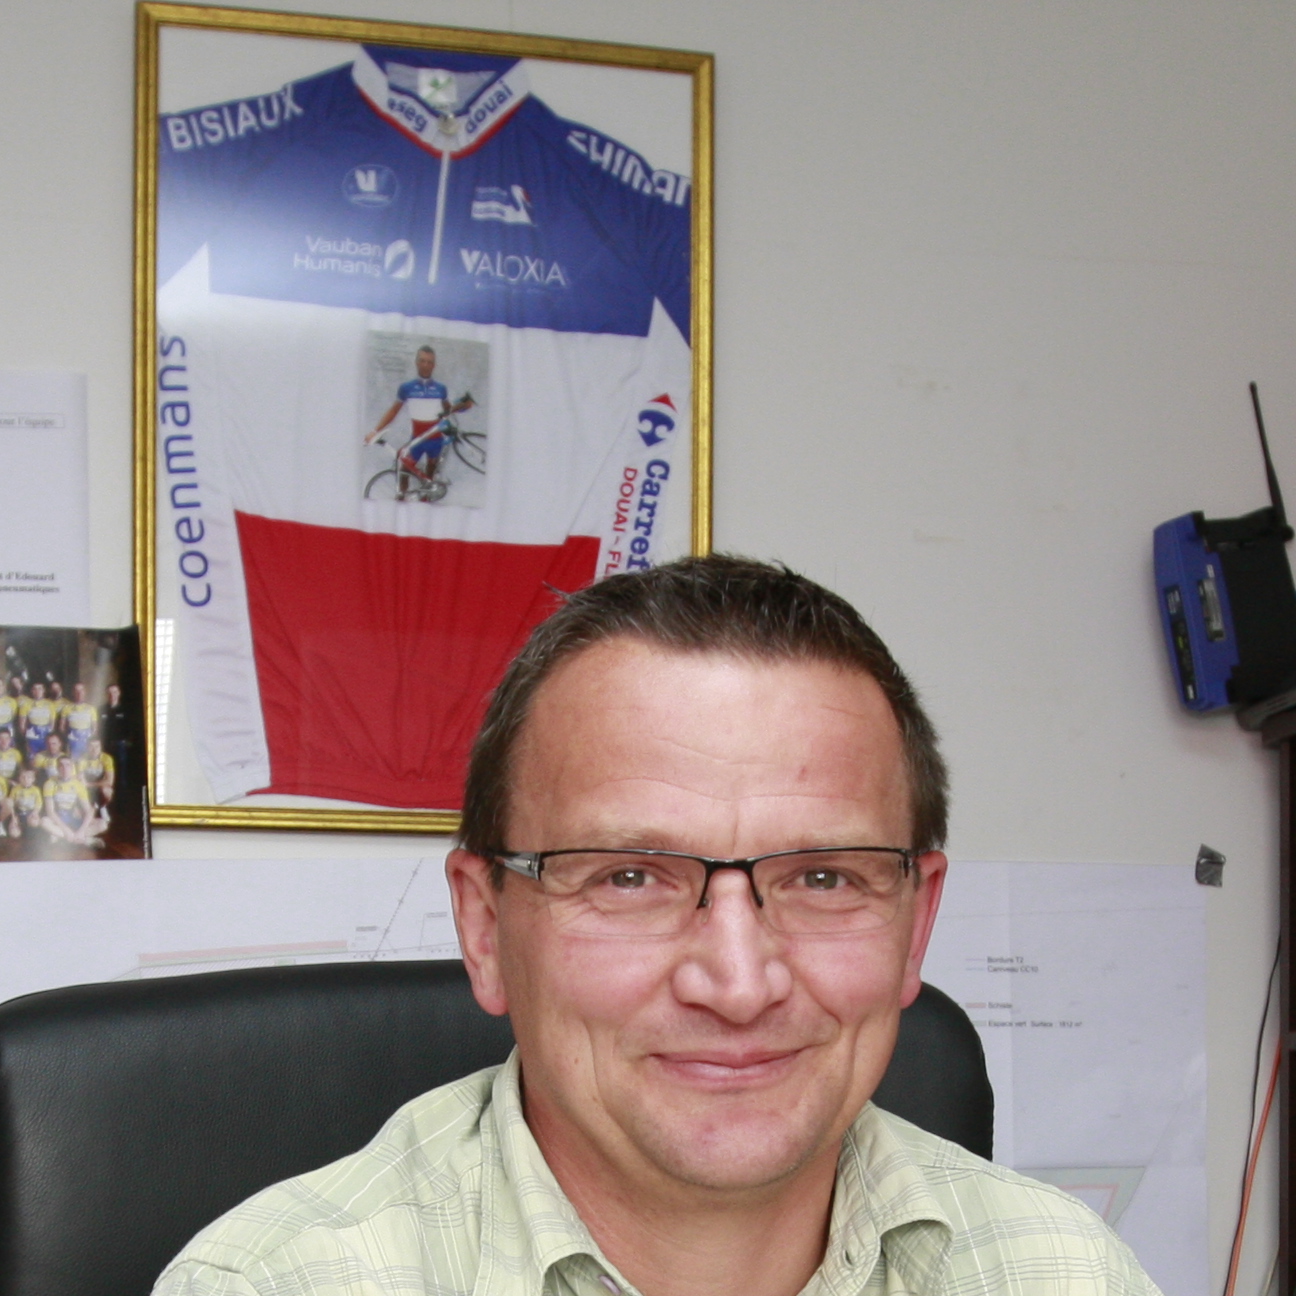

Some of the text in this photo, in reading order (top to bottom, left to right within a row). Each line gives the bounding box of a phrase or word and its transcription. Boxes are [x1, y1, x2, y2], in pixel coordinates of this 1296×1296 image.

[167, 86, 304, 152] BISIAUX
[464, 79, 513, 134] douai
[294, 255, 382, 279] Humanis
[306, 236, 383, 257] Vauban
[460, 248, 568, 287] VALOXIA
[158, 335, 212, 607] coenmans
[612, 467, 638, 532] DOUAI
[626, 458, 671, 576] Carref
